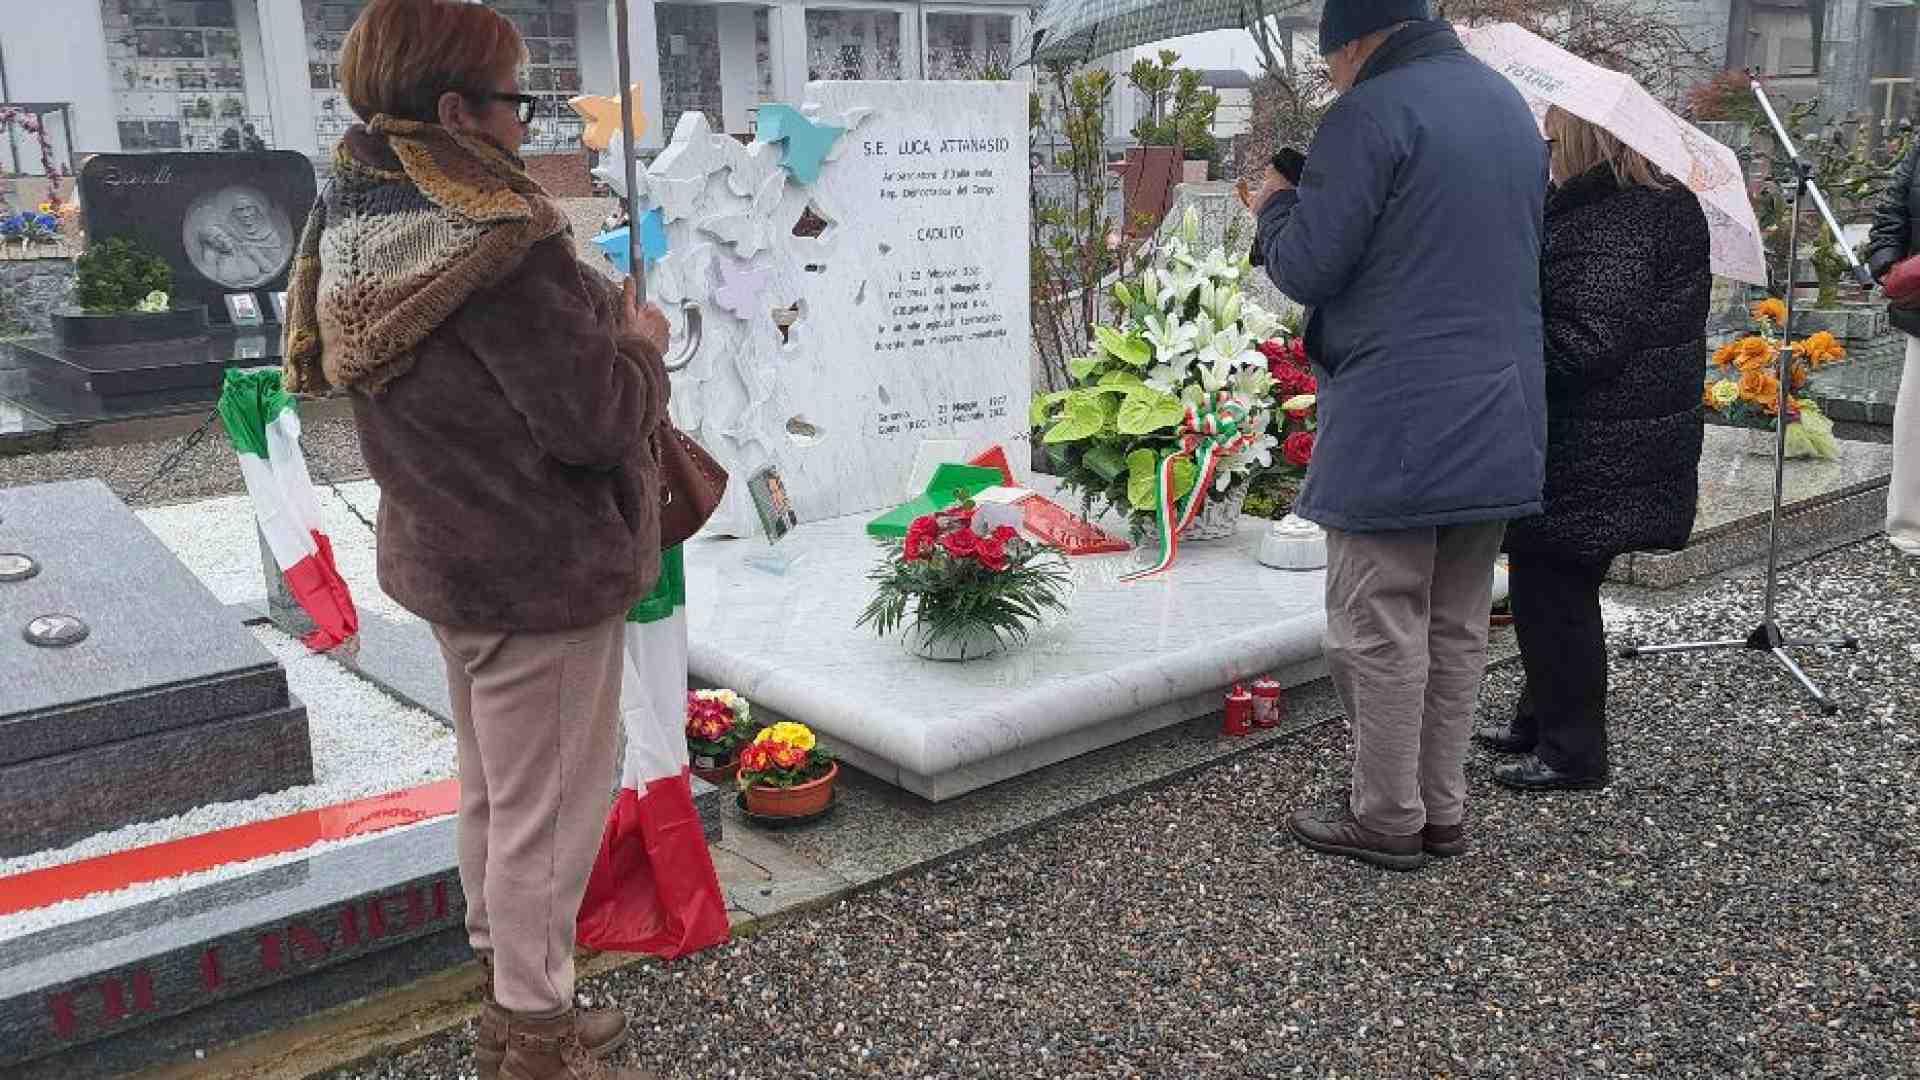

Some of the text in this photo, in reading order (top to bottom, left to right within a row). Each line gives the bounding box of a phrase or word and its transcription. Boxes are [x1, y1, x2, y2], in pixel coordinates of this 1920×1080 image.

[863, 136, 1009, 156] S.E. LUCA ATTANASIO
[917, 225, 964, 241] CADUTO
